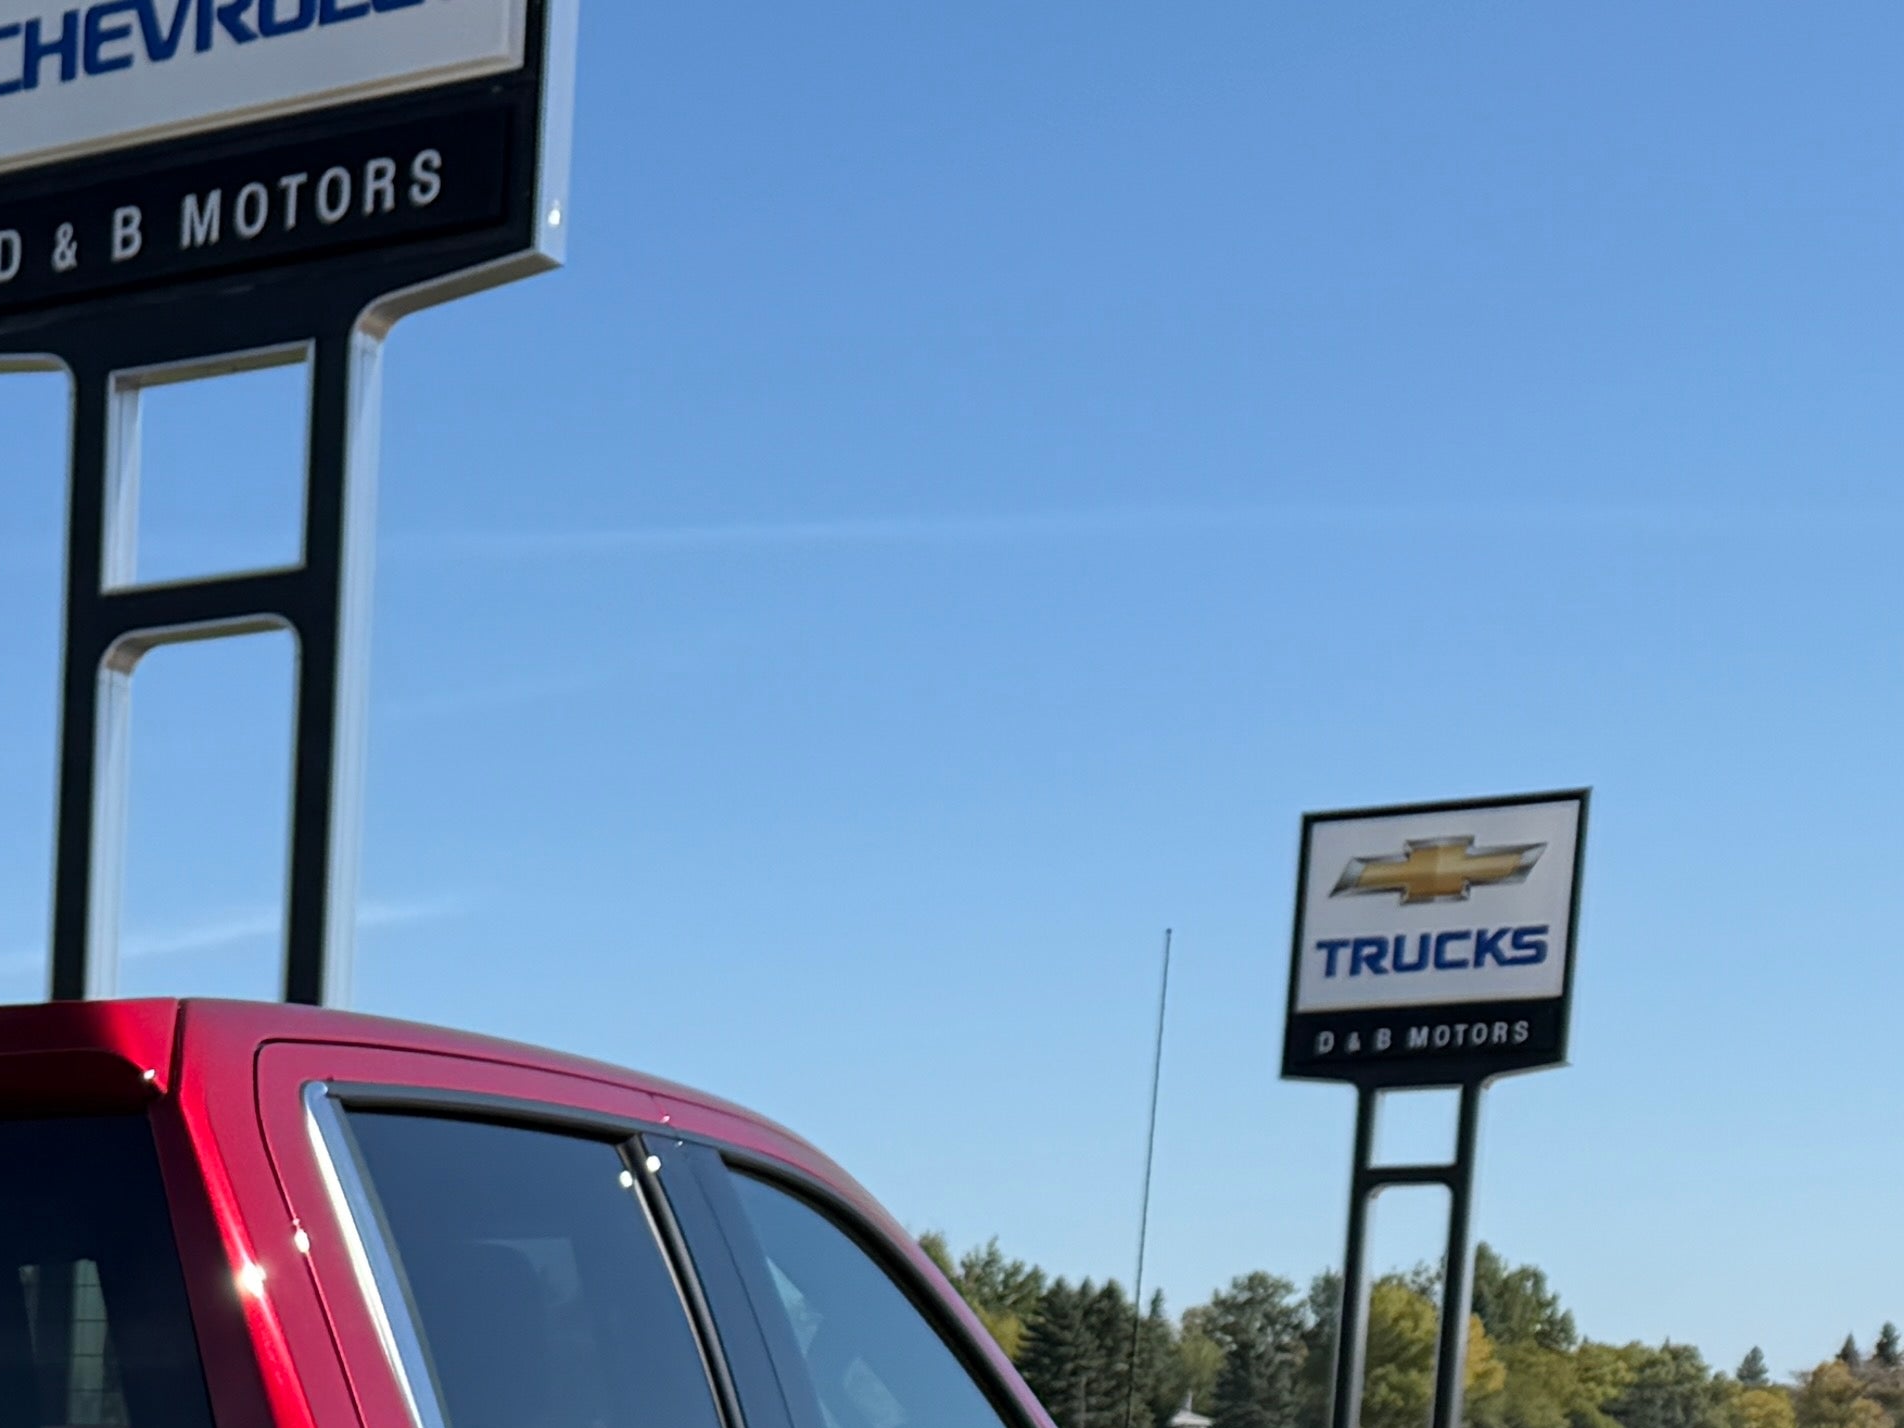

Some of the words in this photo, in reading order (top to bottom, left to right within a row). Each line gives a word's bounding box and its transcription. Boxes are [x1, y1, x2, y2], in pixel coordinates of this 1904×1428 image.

[51, 223, 78, 272] &
[111, 206, 142, 262] B
[180, 149, 444, 250] MOTORS
[1315, 924, 1549, 978] TRUCKS
[1317, 1031, 1335, 1055] D
[1347, 1032, 1361, 1052] &
[1376, 1028, 1391, 1050] B
[1407, 1021, 1530, 1048] MOTORS
